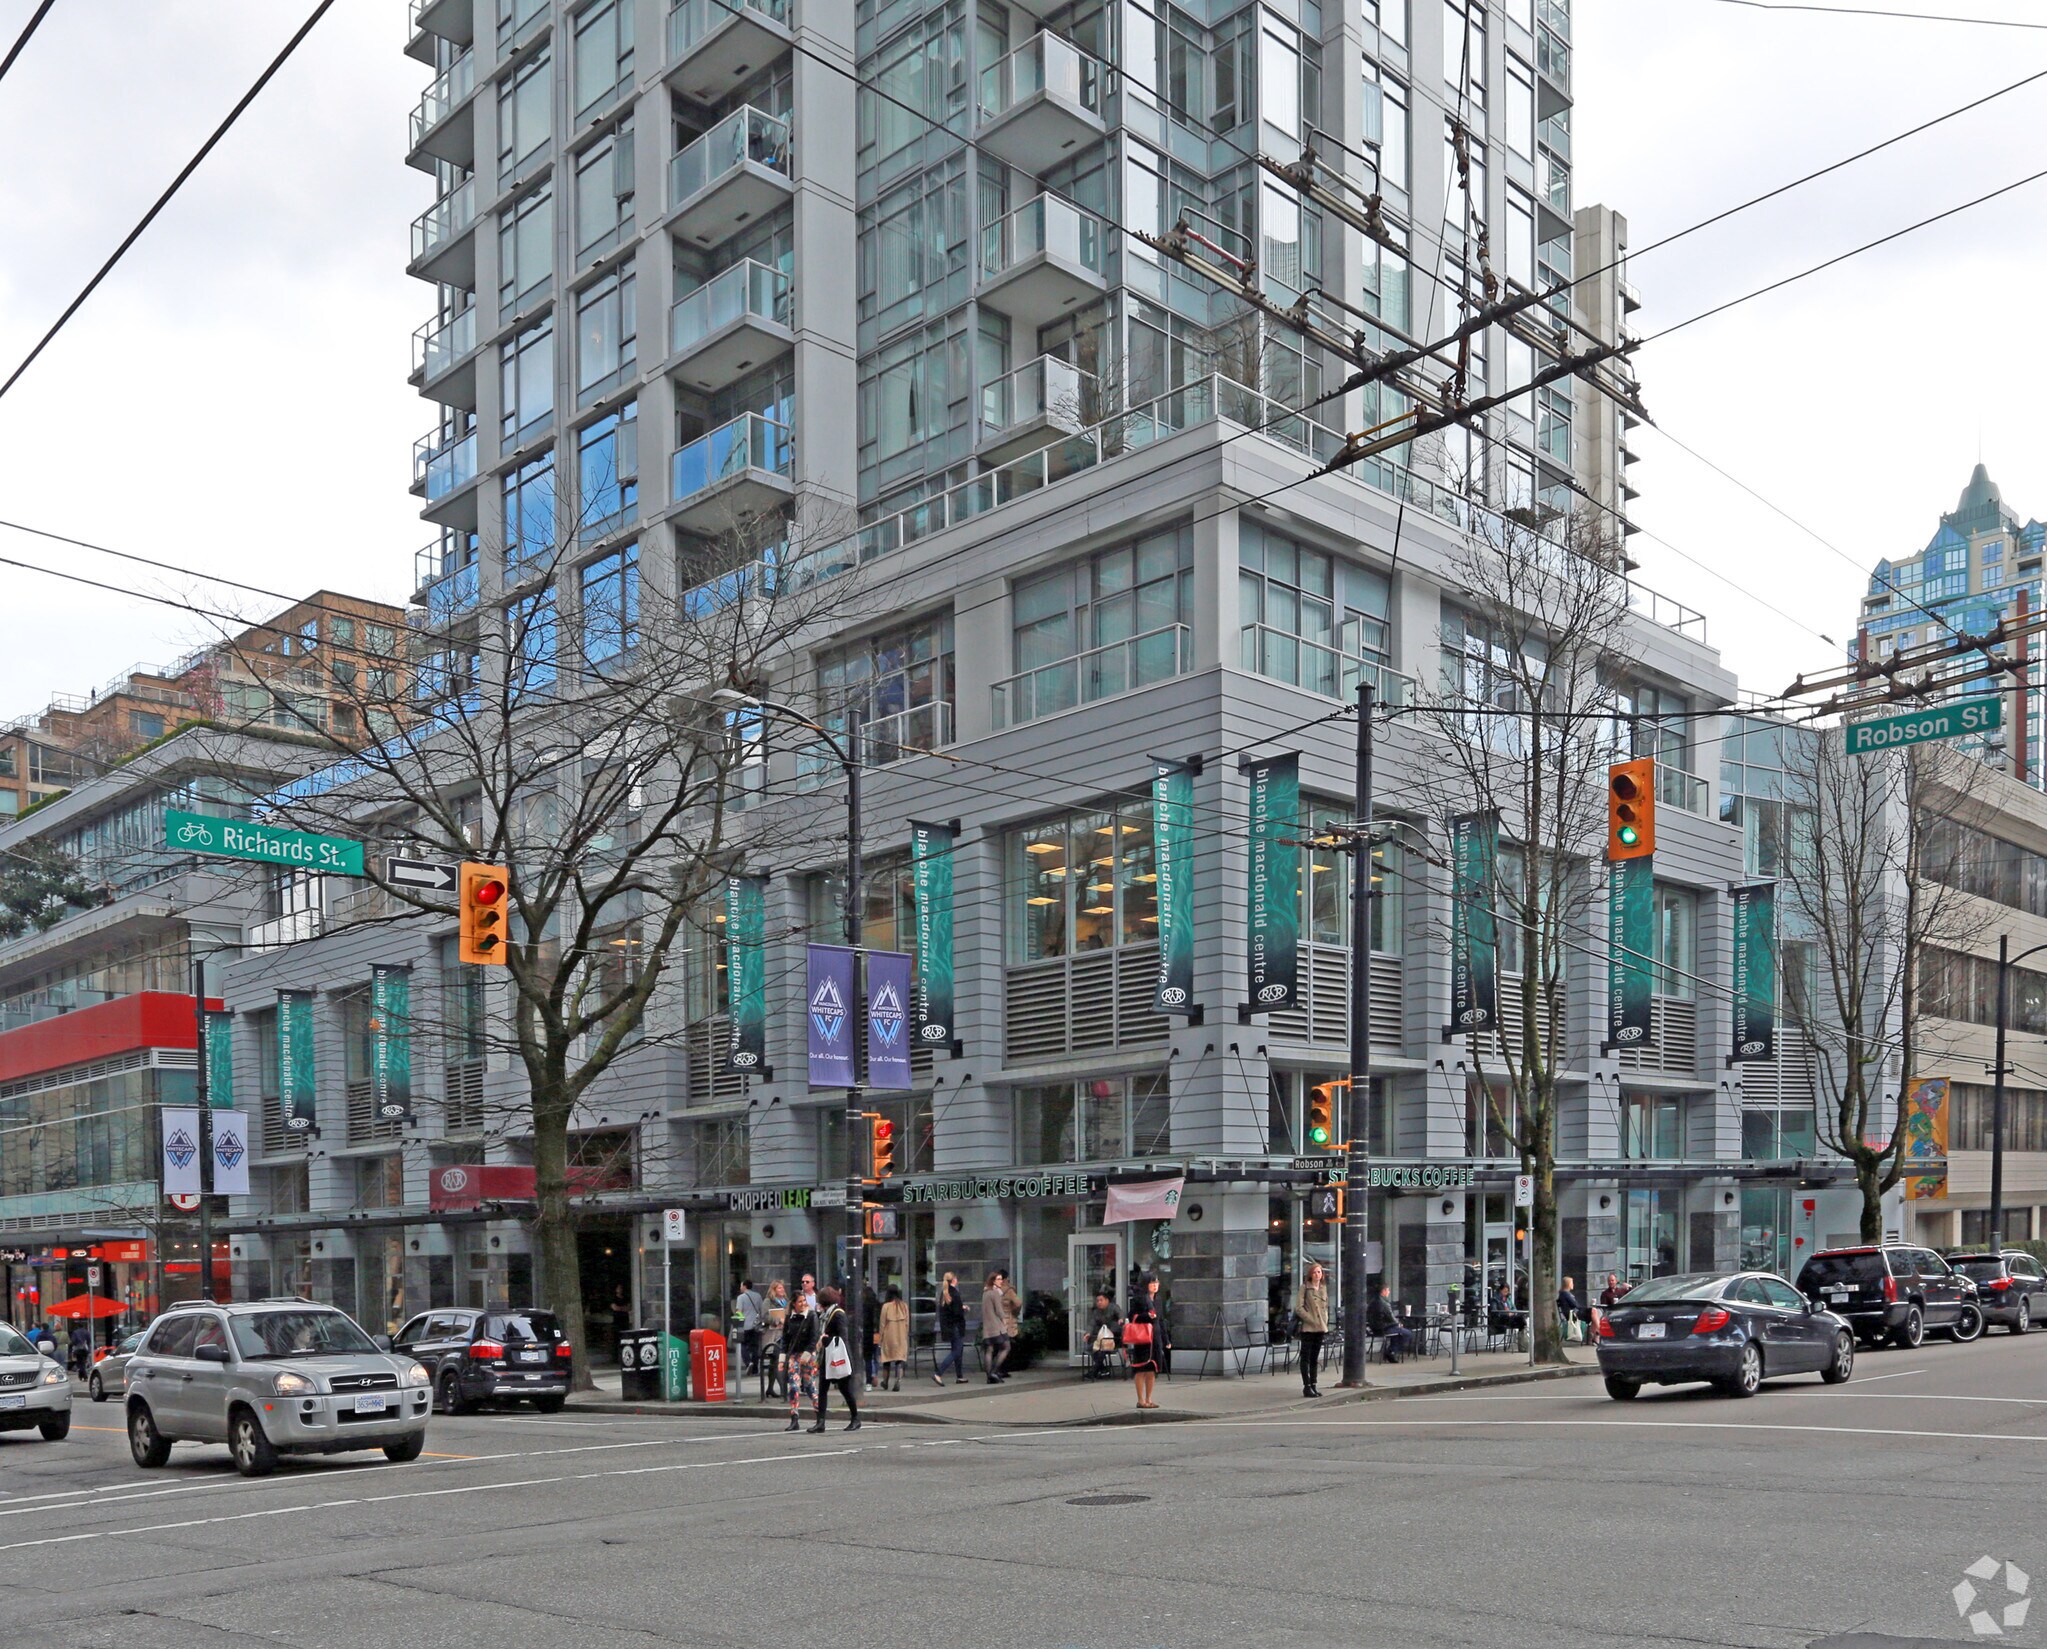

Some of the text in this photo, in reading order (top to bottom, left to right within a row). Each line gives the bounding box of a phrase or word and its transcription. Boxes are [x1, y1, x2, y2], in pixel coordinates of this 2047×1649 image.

[1856, 706, 1989, 748] Robson St
[1158, 766, 1171, 832] blanche
[223, 826, 347, 867] Richards St.
[1160, 838, 1173, 928] macdonald
[1254, 768, 1269, 984] blanche macdonald centre
[921, 892, 930, 972] macdonald
[1738, 893, 1750, 938] blanche
[1457, 965, 1469, 1008] centre
[282, 995, 292, 1032] blanche
[811, 1006, 844, 1016] WHITECAPS
[871, 1011, 903, 1020] WHITECAPS
[1613, 988, 1625, 1027] centre
[1737, 1007, 1748, 1042] centre
[284, 1089, 295, 1118] centre
[1295, 1159, 1324, 1169] Robson
[1328, 1167, 1475, 1187] STBUCKS COFFEE
[903, 1175, 1088, 1203] STARBUCKS COFFEE
[708, 1349, 720, 1361] 24
